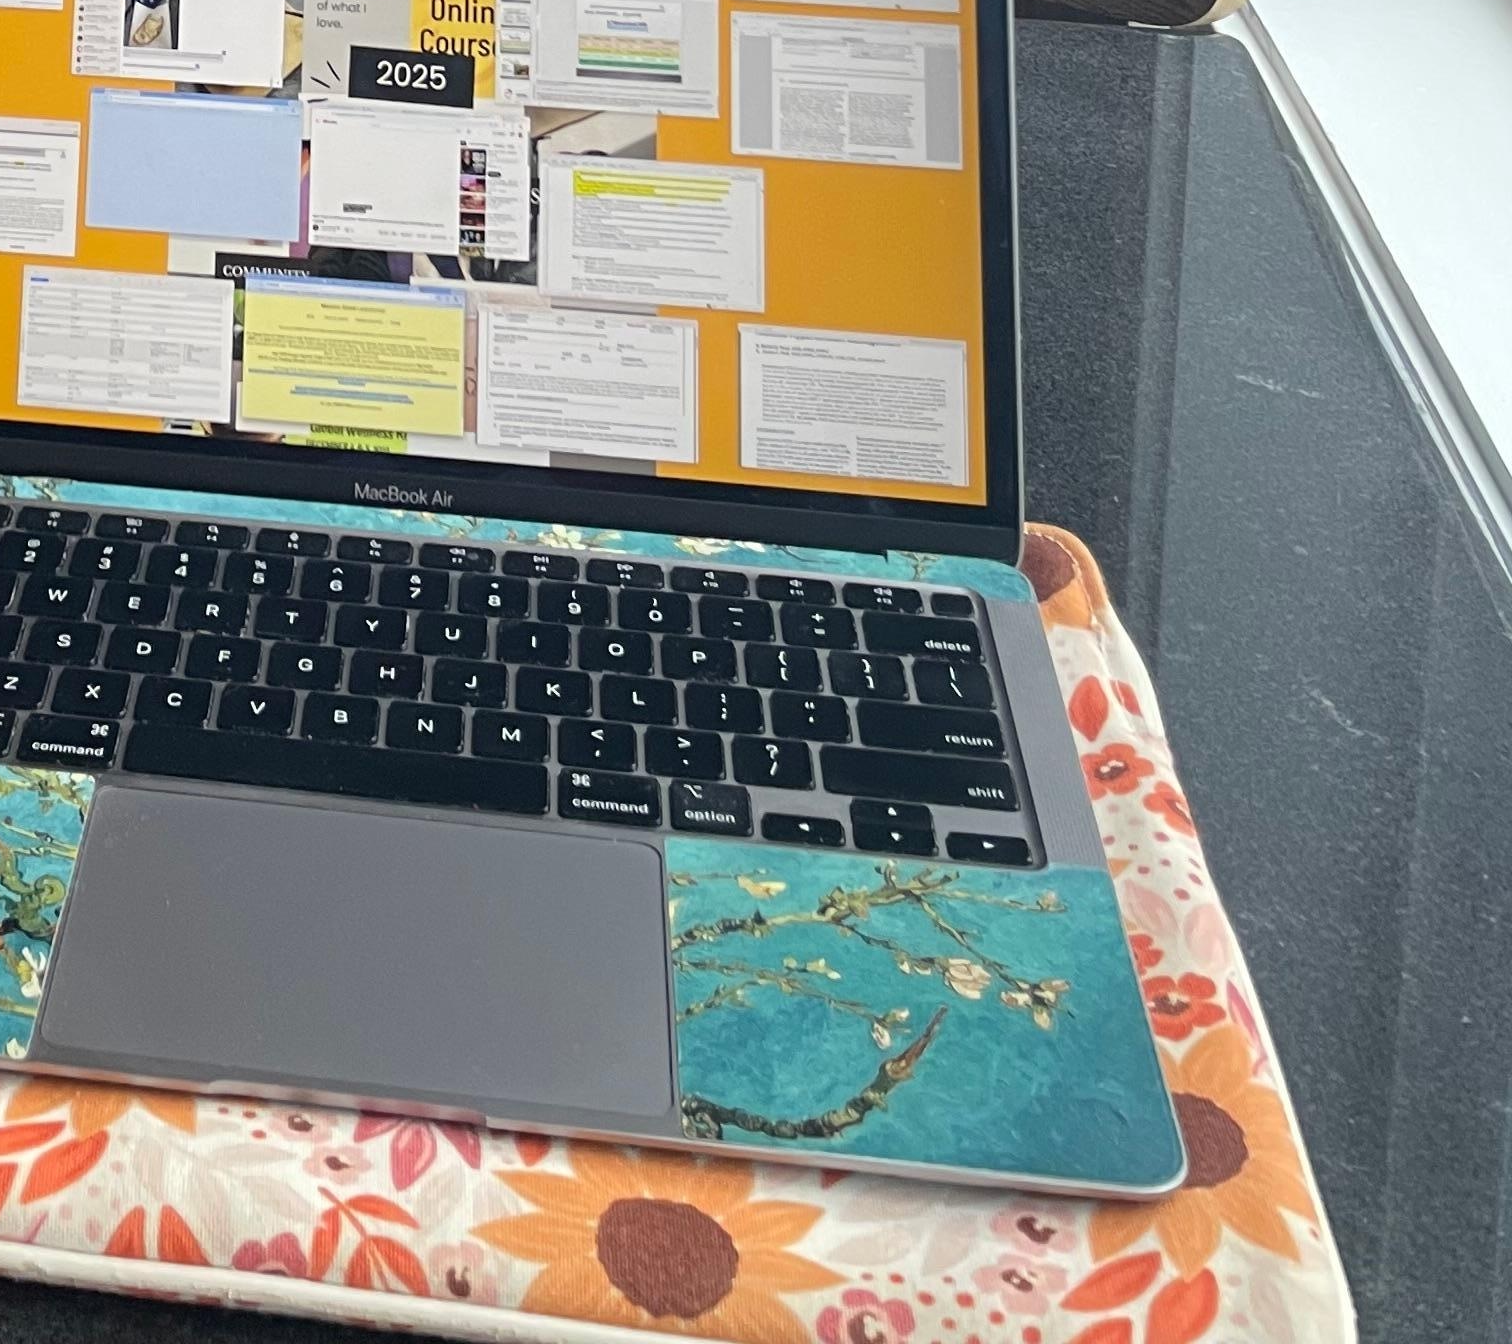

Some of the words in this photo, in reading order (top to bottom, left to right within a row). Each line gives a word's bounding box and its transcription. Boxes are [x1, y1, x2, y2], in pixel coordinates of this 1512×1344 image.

[316, 0, 332, 12] of
[332, 1, 361, 13] what
[316, 16, 344, 29] love.
[375, 60, 448, 91] 2025
[353, 481, 429, 506] MacBook
[430, 489, 454, 508] Air
[22, 549, 37, 564] 2
[97, 556, 112, 571] 3
[173, 564, 188, 578] 4
[251, 571, 266, 586] 5
[328, 578, 344, 593] 6
[408, 585, 422, 600] 7
[47, 587, 70, 603] W
[126, 595, 142, 611] E
[486, 593, 503, 608] 8
[204, 602, 221, 619] R
[566, 601, 583, 616] 9
[284, 610, 300, 626] T
[364, 618, 380, 633] Y
[55, 632, 73, 648] S
[443, 626, 462, 642] U
[135, 640, 153, 656] D
[923, 638, 972, 653] delete
[217, 648, 232, 664] F
[691, 649, 708, 665] P
[296, 657, 315, 673] G
[378, 665, 397, 681] H
[2, 674, 20, 691] Z
[463, 674, 478, 690] J
[545, 681, 562, 699] K
[83, 683, 102, 700] X
[166, 691, 184, 708] C
[631, 690, 647, 707] L
[249, 699, 267, 716] V
[332, 708, 350, 725] B
[416, 717, 435, 735] N
[500, 725, 522, 743] M
[943, 733, 995, 748] return
[30, 740, 106, 758] command
[966, 786, 1006, 801] shift
[571, 797, 650, 815] command
[683, 808, 737, 825] option
